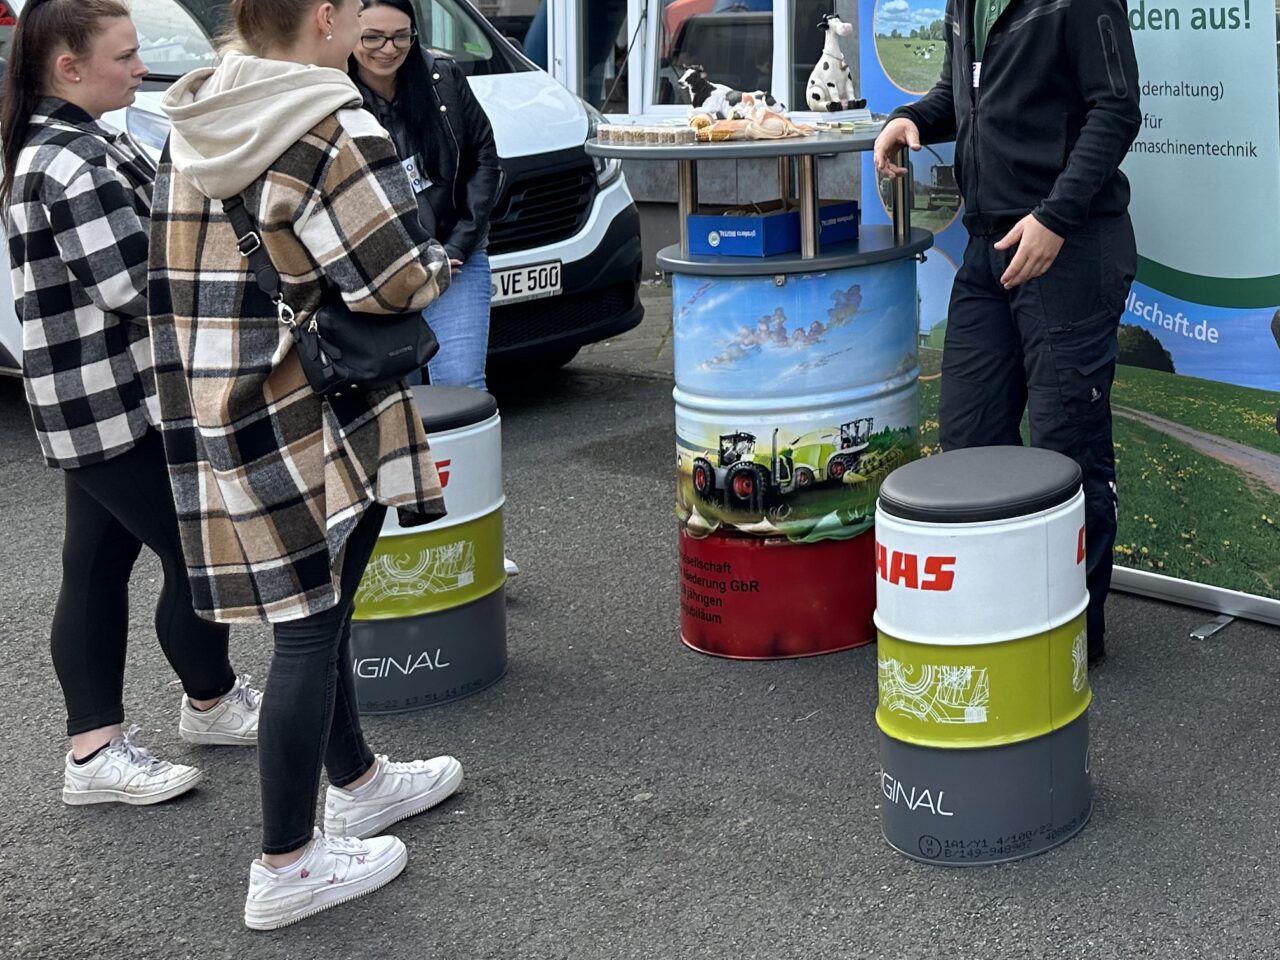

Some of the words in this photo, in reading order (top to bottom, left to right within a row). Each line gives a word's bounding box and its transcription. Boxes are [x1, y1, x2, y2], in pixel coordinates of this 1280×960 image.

[1128, 0, 1180, 30] den
[1190, 0, 1250, 30] aus!
[1141, 81, 1225, 101] derhaltung)
[1143, 113, 1163, 129] für
[500, 271, 522, 296] VE
[527, 265, 558, 291] 500
[730, 580, 760, 593] GbR
